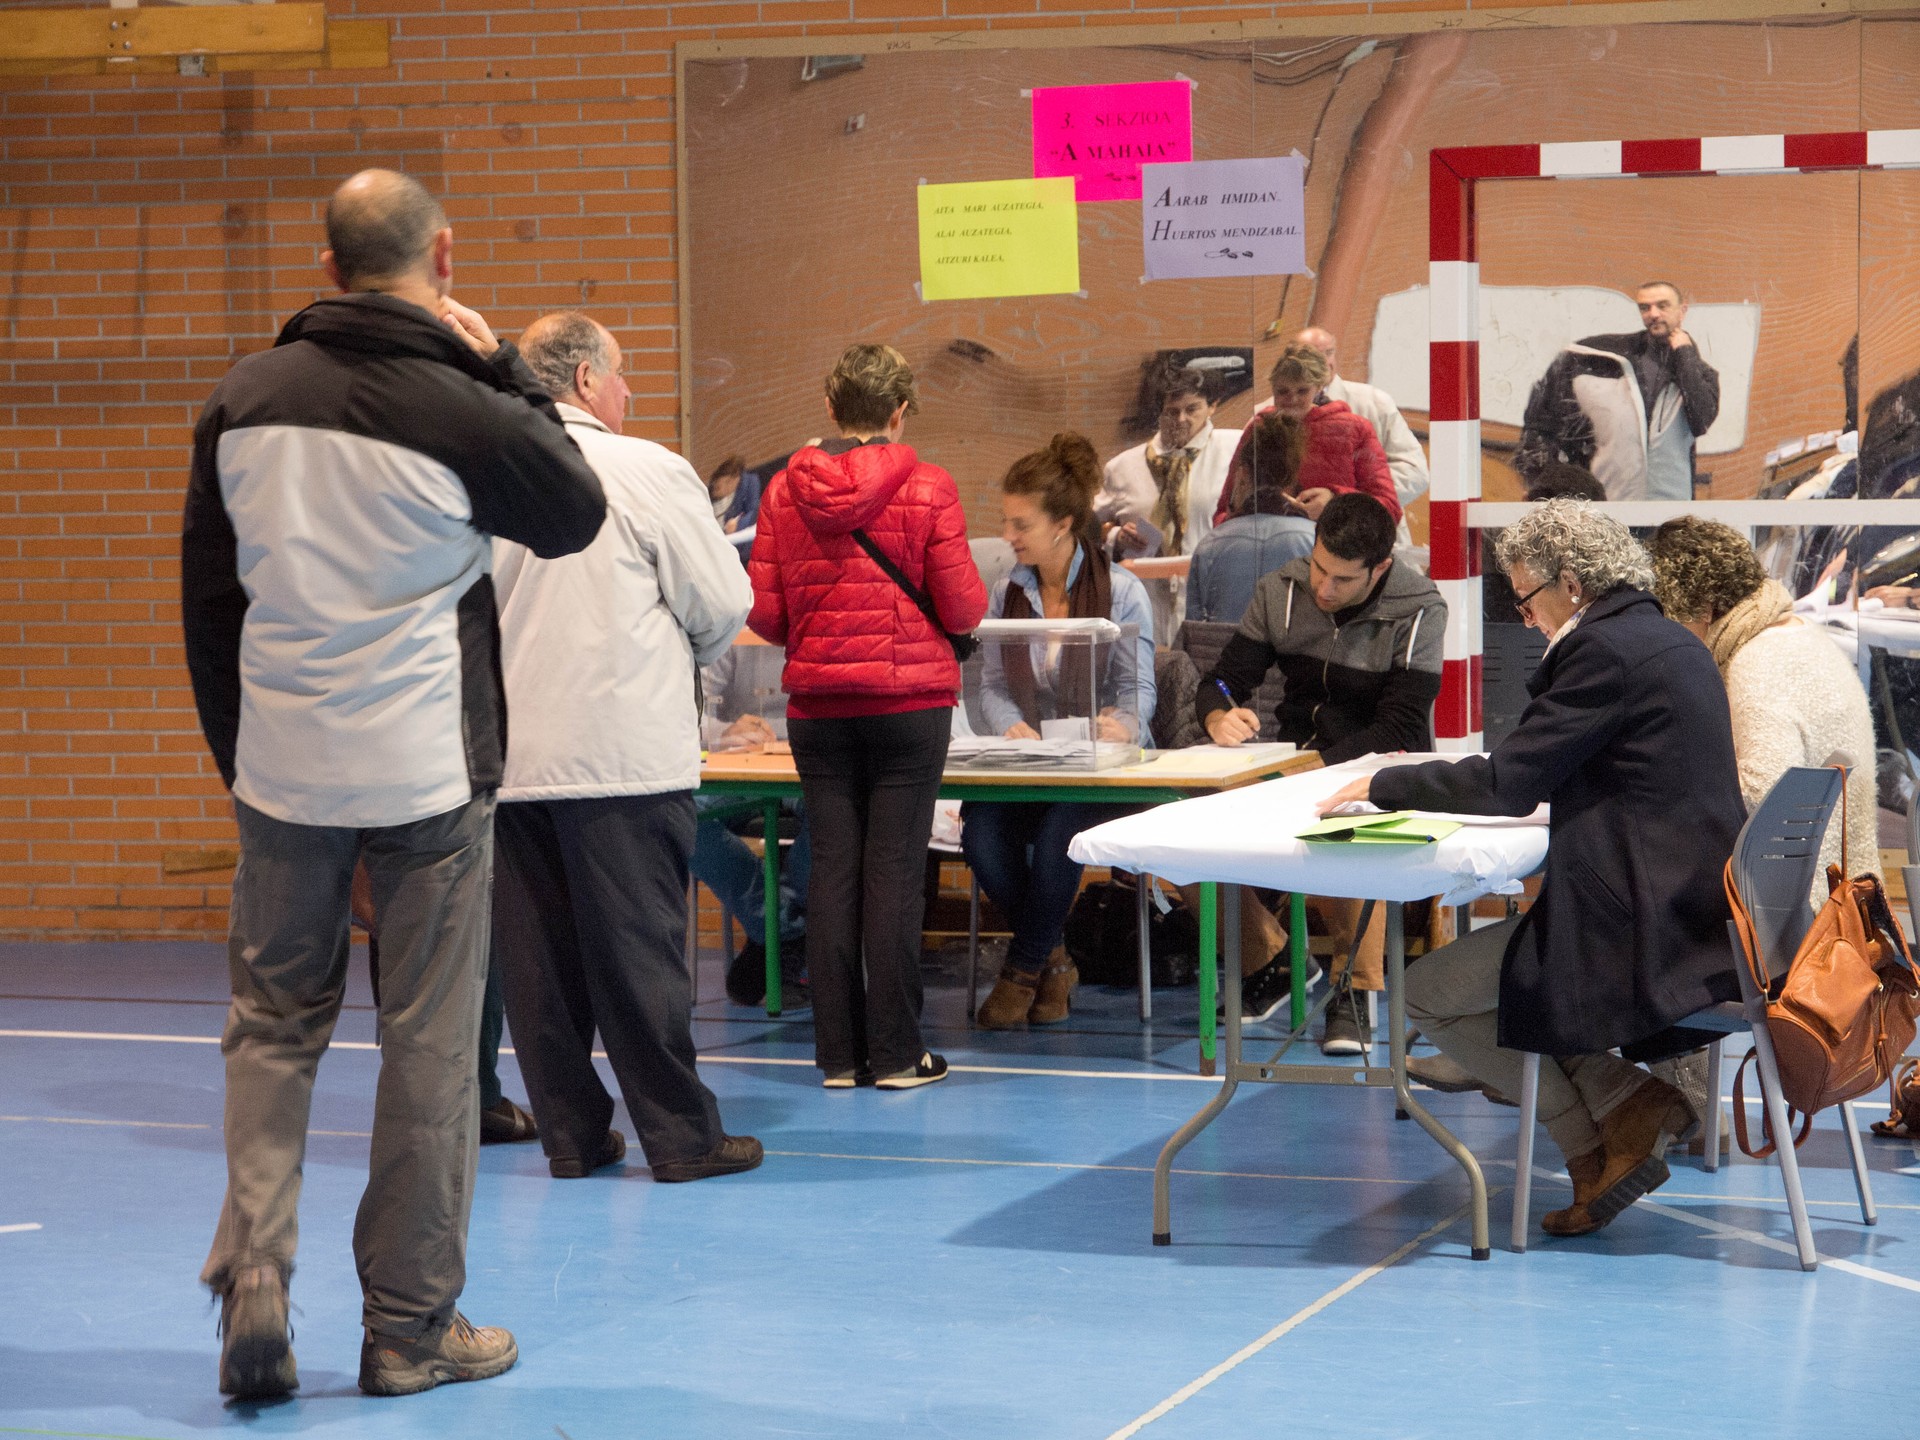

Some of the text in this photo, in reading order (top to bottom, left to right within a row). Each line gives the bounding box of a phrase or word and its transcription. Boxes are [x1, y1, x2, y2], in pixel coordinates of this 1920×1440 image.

[1060, 111, 1172, 129] 3. SEKZIOA
[1153, 186, 1208, 207] AARAB
[934, 206, 955, 214] AITA
[963, 204, 987, 213] MARI
[935, 230, 956, 238] ALAI
[1151, 219, 1217, 240] HUERTOS
[935, 256, 971, 264] AITZURI
